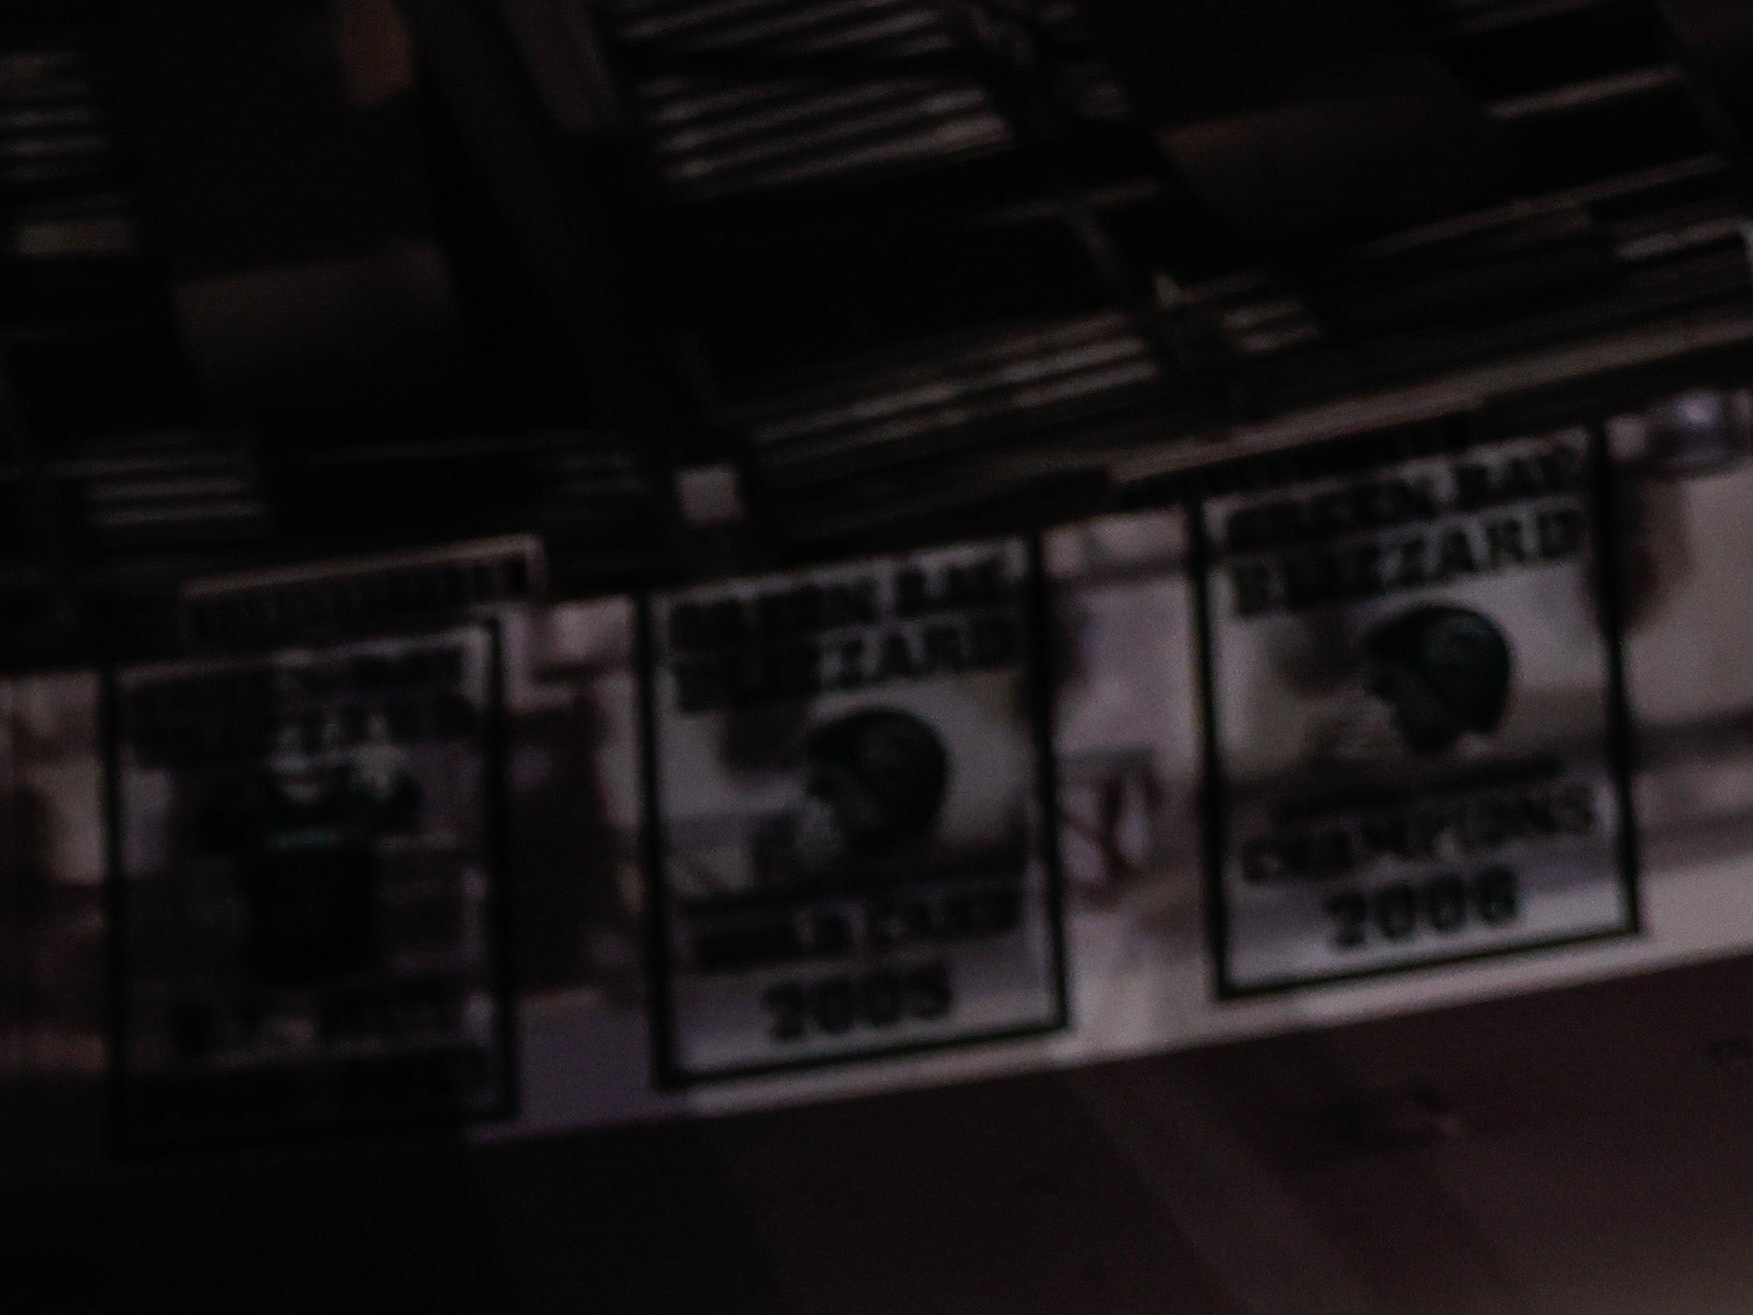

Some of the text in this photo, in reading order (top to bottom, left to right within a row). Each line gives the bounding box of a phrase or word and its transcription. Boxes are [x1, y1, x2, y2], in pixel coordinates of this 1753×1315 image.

[1233, 506, 1587, 618] BLIZZARD
[1240, 784, 1596, 884] CHAMPIONS
[1327, 865, 1521, 950] 2006
[765, 957, 953, 1040] 2005
